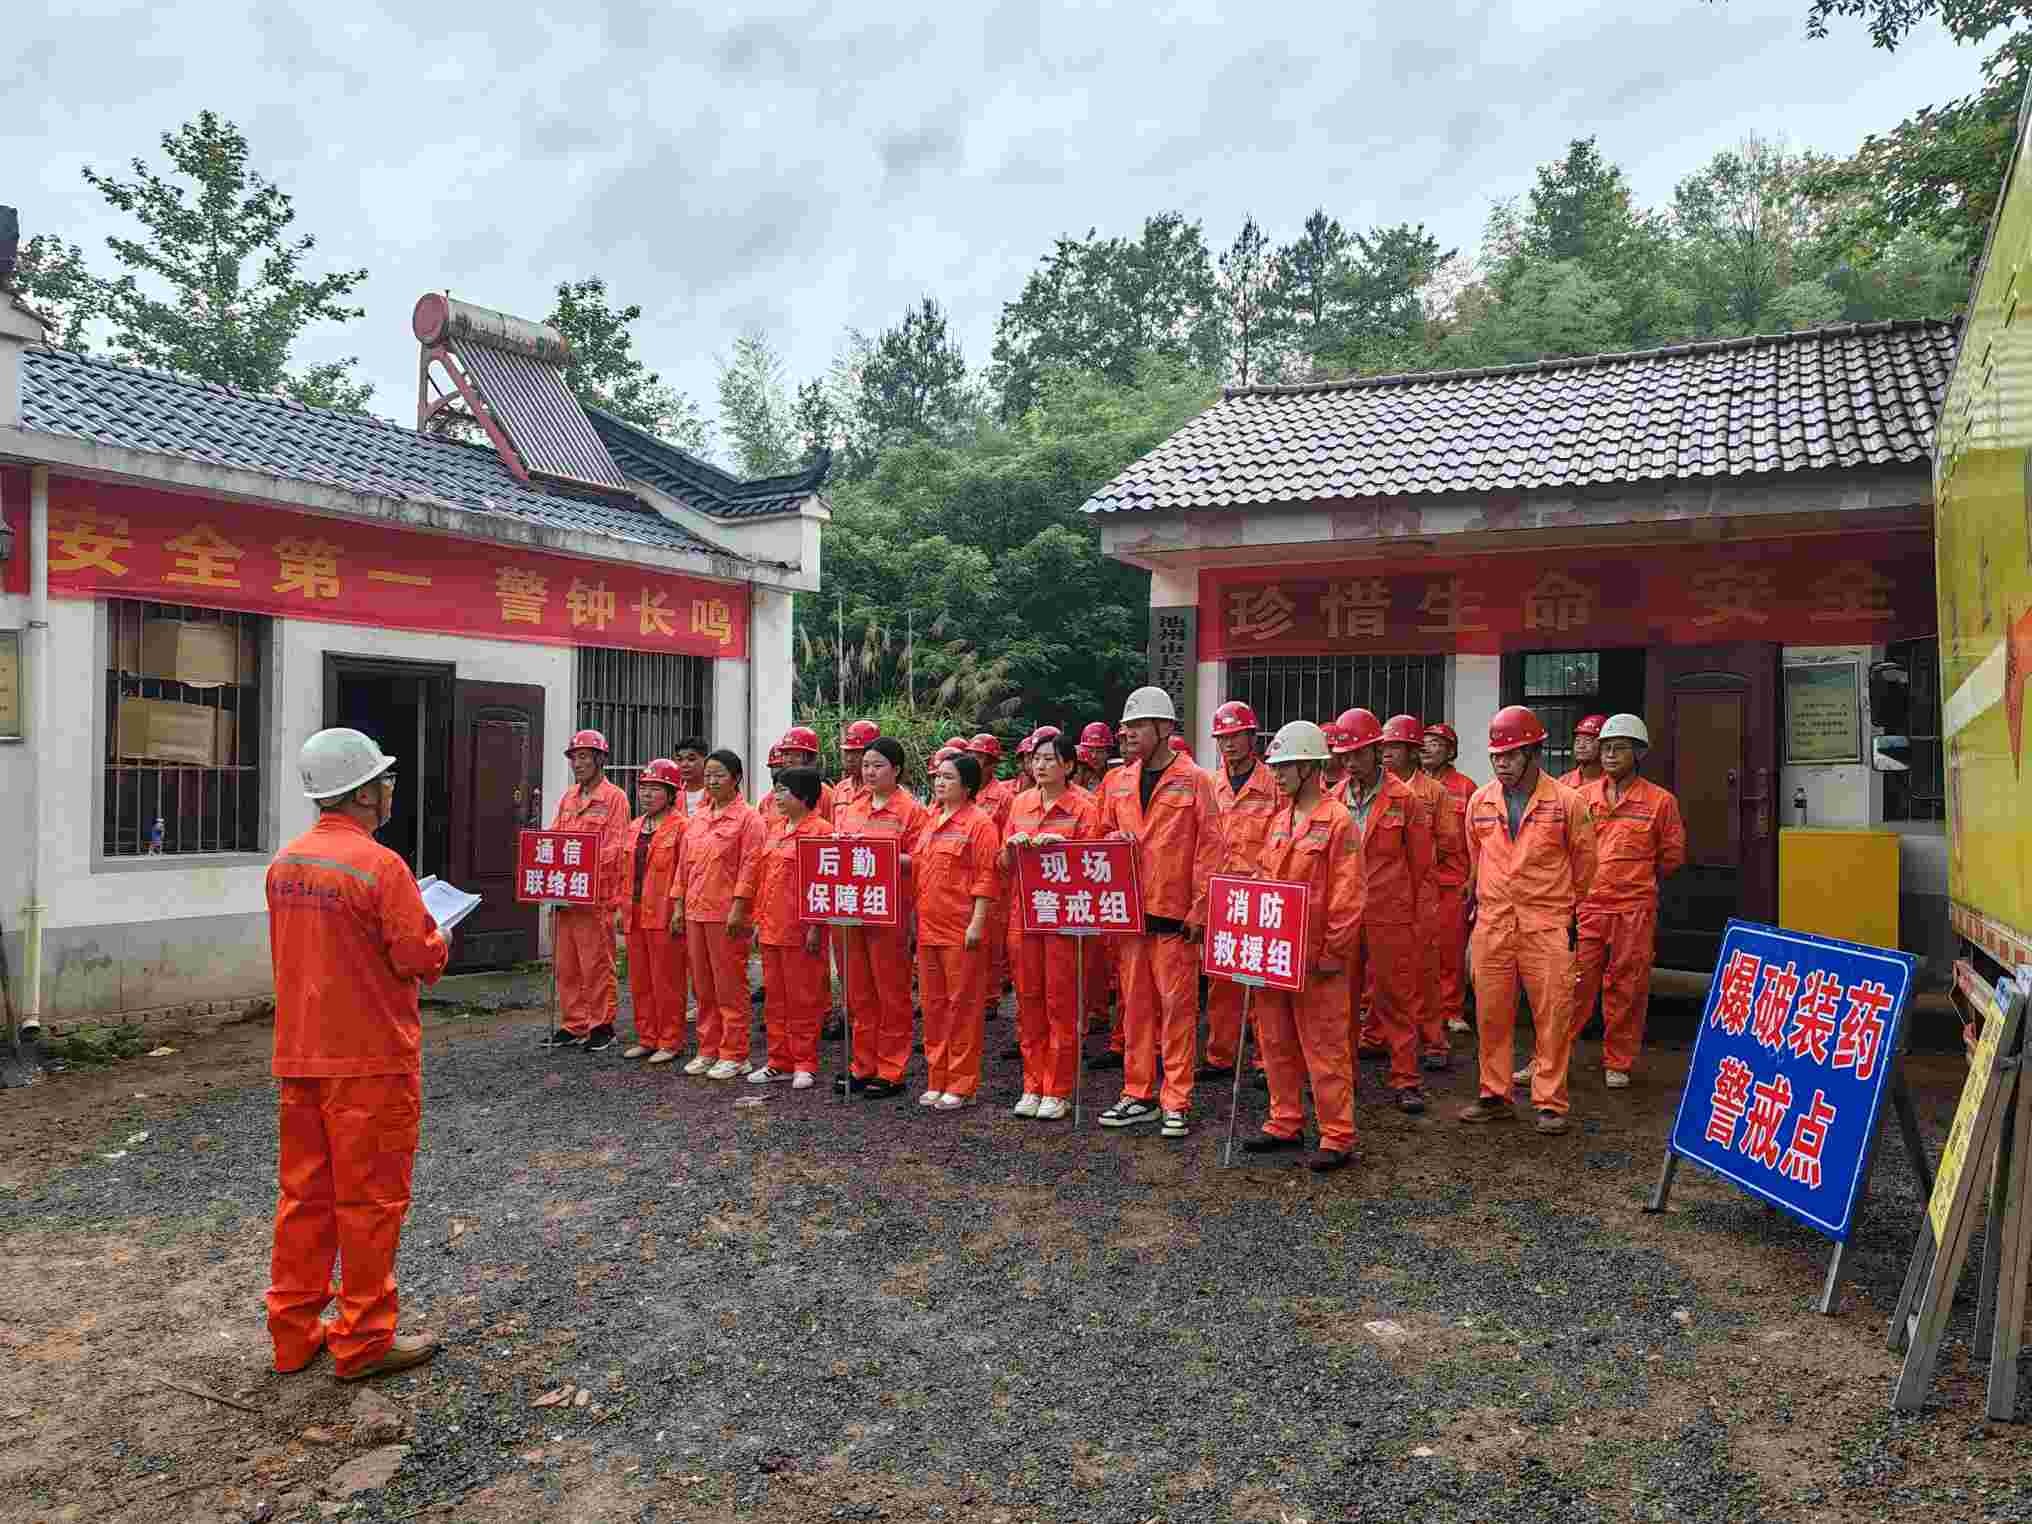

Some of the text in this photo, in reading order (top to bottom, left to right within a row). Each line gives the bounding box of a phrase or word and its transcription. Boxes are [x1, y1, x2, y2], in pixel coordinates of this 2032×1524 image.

[48, 504, 732, 646] 安全第一 警钟长鸣
[1228, 558, 1896, 640] 珍惜生命 安全
[534, 838, 583, 866] 通信
[817, 846, 876, 877] 后勤
[1039, 850, 1113, 883] 现场
[524, 869, 591, 897] 联络组
[806, 882, 889, 916] 保障组
[1031, 890, 1131, 925] 警戒组
[1226, 888, 1285, 929] 消防
[1213, 930, 1294, 978] 救援组
[1710, 949, 1894, 1080] 爆破装药
[1704, 1056, 1837, 1190] 警戒点
